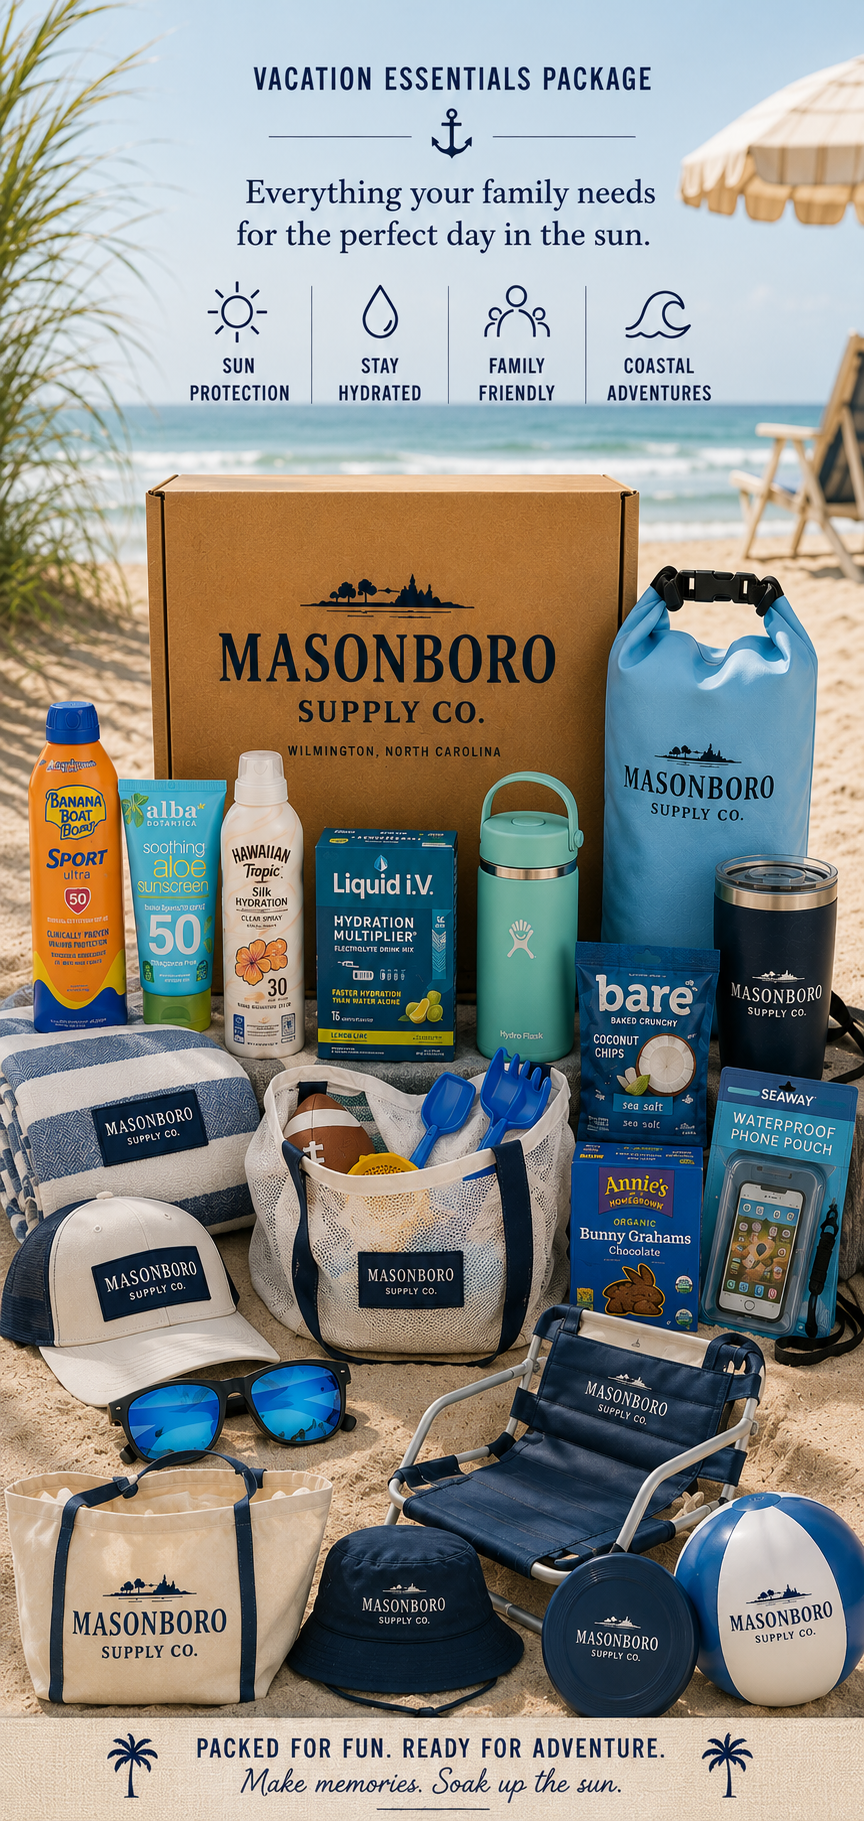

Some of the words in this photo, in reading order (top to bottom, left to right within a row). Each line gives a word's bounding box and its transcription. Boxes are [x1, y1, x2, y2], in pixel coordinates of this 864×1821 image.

[218, 632, 556, 684] MASONBORO
[298, 700, 420, 723] SUPPLY
[432, 700, 484, 724] CO.
[288, 745, 379, 758] WILMINGTON,
[385, 746, 429, 757] NORTH
[435, 746, 501, 757] CAROLINA
[624, 765, 774, 801] MASONBORO
[50, 792, 102, 808] BANANA
[60, 810, 93, 823] BOAT
[147, 801, 197, 818] alba
[651, 802, 710, 821] SUPPLY
[718, 809, 744, 821] CO.
[143, 840, 205, 858] soothing
[232, 844, 291, 864] HAWAIIAN
[46, 848, 108, 869] SPORT
[154, 855, 206, 877] aloe
[64, 870, 90, 880] ultra
[243, 863, 280, 882] Tropic
[138, 881, 208, 893] sunscreen
[252, 887, 271, 897] Silk
[333, 873, 400, 899] Liquid
[406, 874, 433, 895] i.V.
[69, 893, 86, 905] 50
[236, 898, 288, 907] HYDRATION
[334, 915, 414, 929] HYDRATION
[149, 914, 201, 955] 50
[268, 978, 287, 997] 30
[595, 974, 693, 1016] bare
[731, 982, 822, 1005] MASONBORO
[747, 1007, 787, 1018] SUPPLY
[791, 1008, 806, 1018] CO.
[611, 1017, 636, 1025] BAKED
[639, 1018, 677, 1027] CRUNCHY
[500, 1030, 522, 1039] Hydro
[593, 1034, 639, 1046] COCONUT
[595, 1048, 624, 1059] CHIPS
[622, 1102, 638, 1110] sea
[643, 1102, 663, 1112] salt
[761, 1089, 814, 1107] SEAWAY
[105, 1106, 193, 1137] MASONBORO
[733, 1112, 836, 1139] WATERPROOF
[127, 1131, 161, 1146] SUPPLY
[164, 1128, 180, 1138] CO.
[731, 1129, 778, 1147] PHONE
[784, 1138, 833, 1156] POUCH
[605, 1175, 669, 1198] Annie's
[613, 1218, 656, 1227] ORGANIC
[580, 1227, 625, 1244] Bunny
[629, 1230, 691, 1244] Grahams
[609, 1246, 661, 1257] Chocolate
[104, 1261, 197, 1293] MASONBORO
[368, 1267, 455, 1283] MASONBORO
[130, 1284, 167, 1301] SUPPLY
[170, 1282, 186, 1291] CO.
[385, 1287, 418, 1295] SUPPLY
[422, 1287, 437, 1295] CO.
[585, 1380, 668, 1417] MASONBORO
[597, 1403, 631, 1421] SUPPLY
[633, 1414, 647, 1426] CO.
[362, 1597, 446, 1613] MASONBORO
[72, 1608, 228, 1636] MASONBORO
[378, 1616, 412, 1625] SUPPLY
[415, 1616, 430, 1625] CO.
[729, 1600, 833, 1633] MASONBORO
[575, 1629, 659, 1652] MASONBORO
[754, 1631, 795, 1644] SUPPLY
[799, 1627, 816, 1638] CO.
[101, 1645, 163, 1660] SUPPLY
[170, 1643, 198, 1658] CO.
[590, 1649, 623, 1661] SUPPLY
[626, 1652, 641, 1662] CO.
